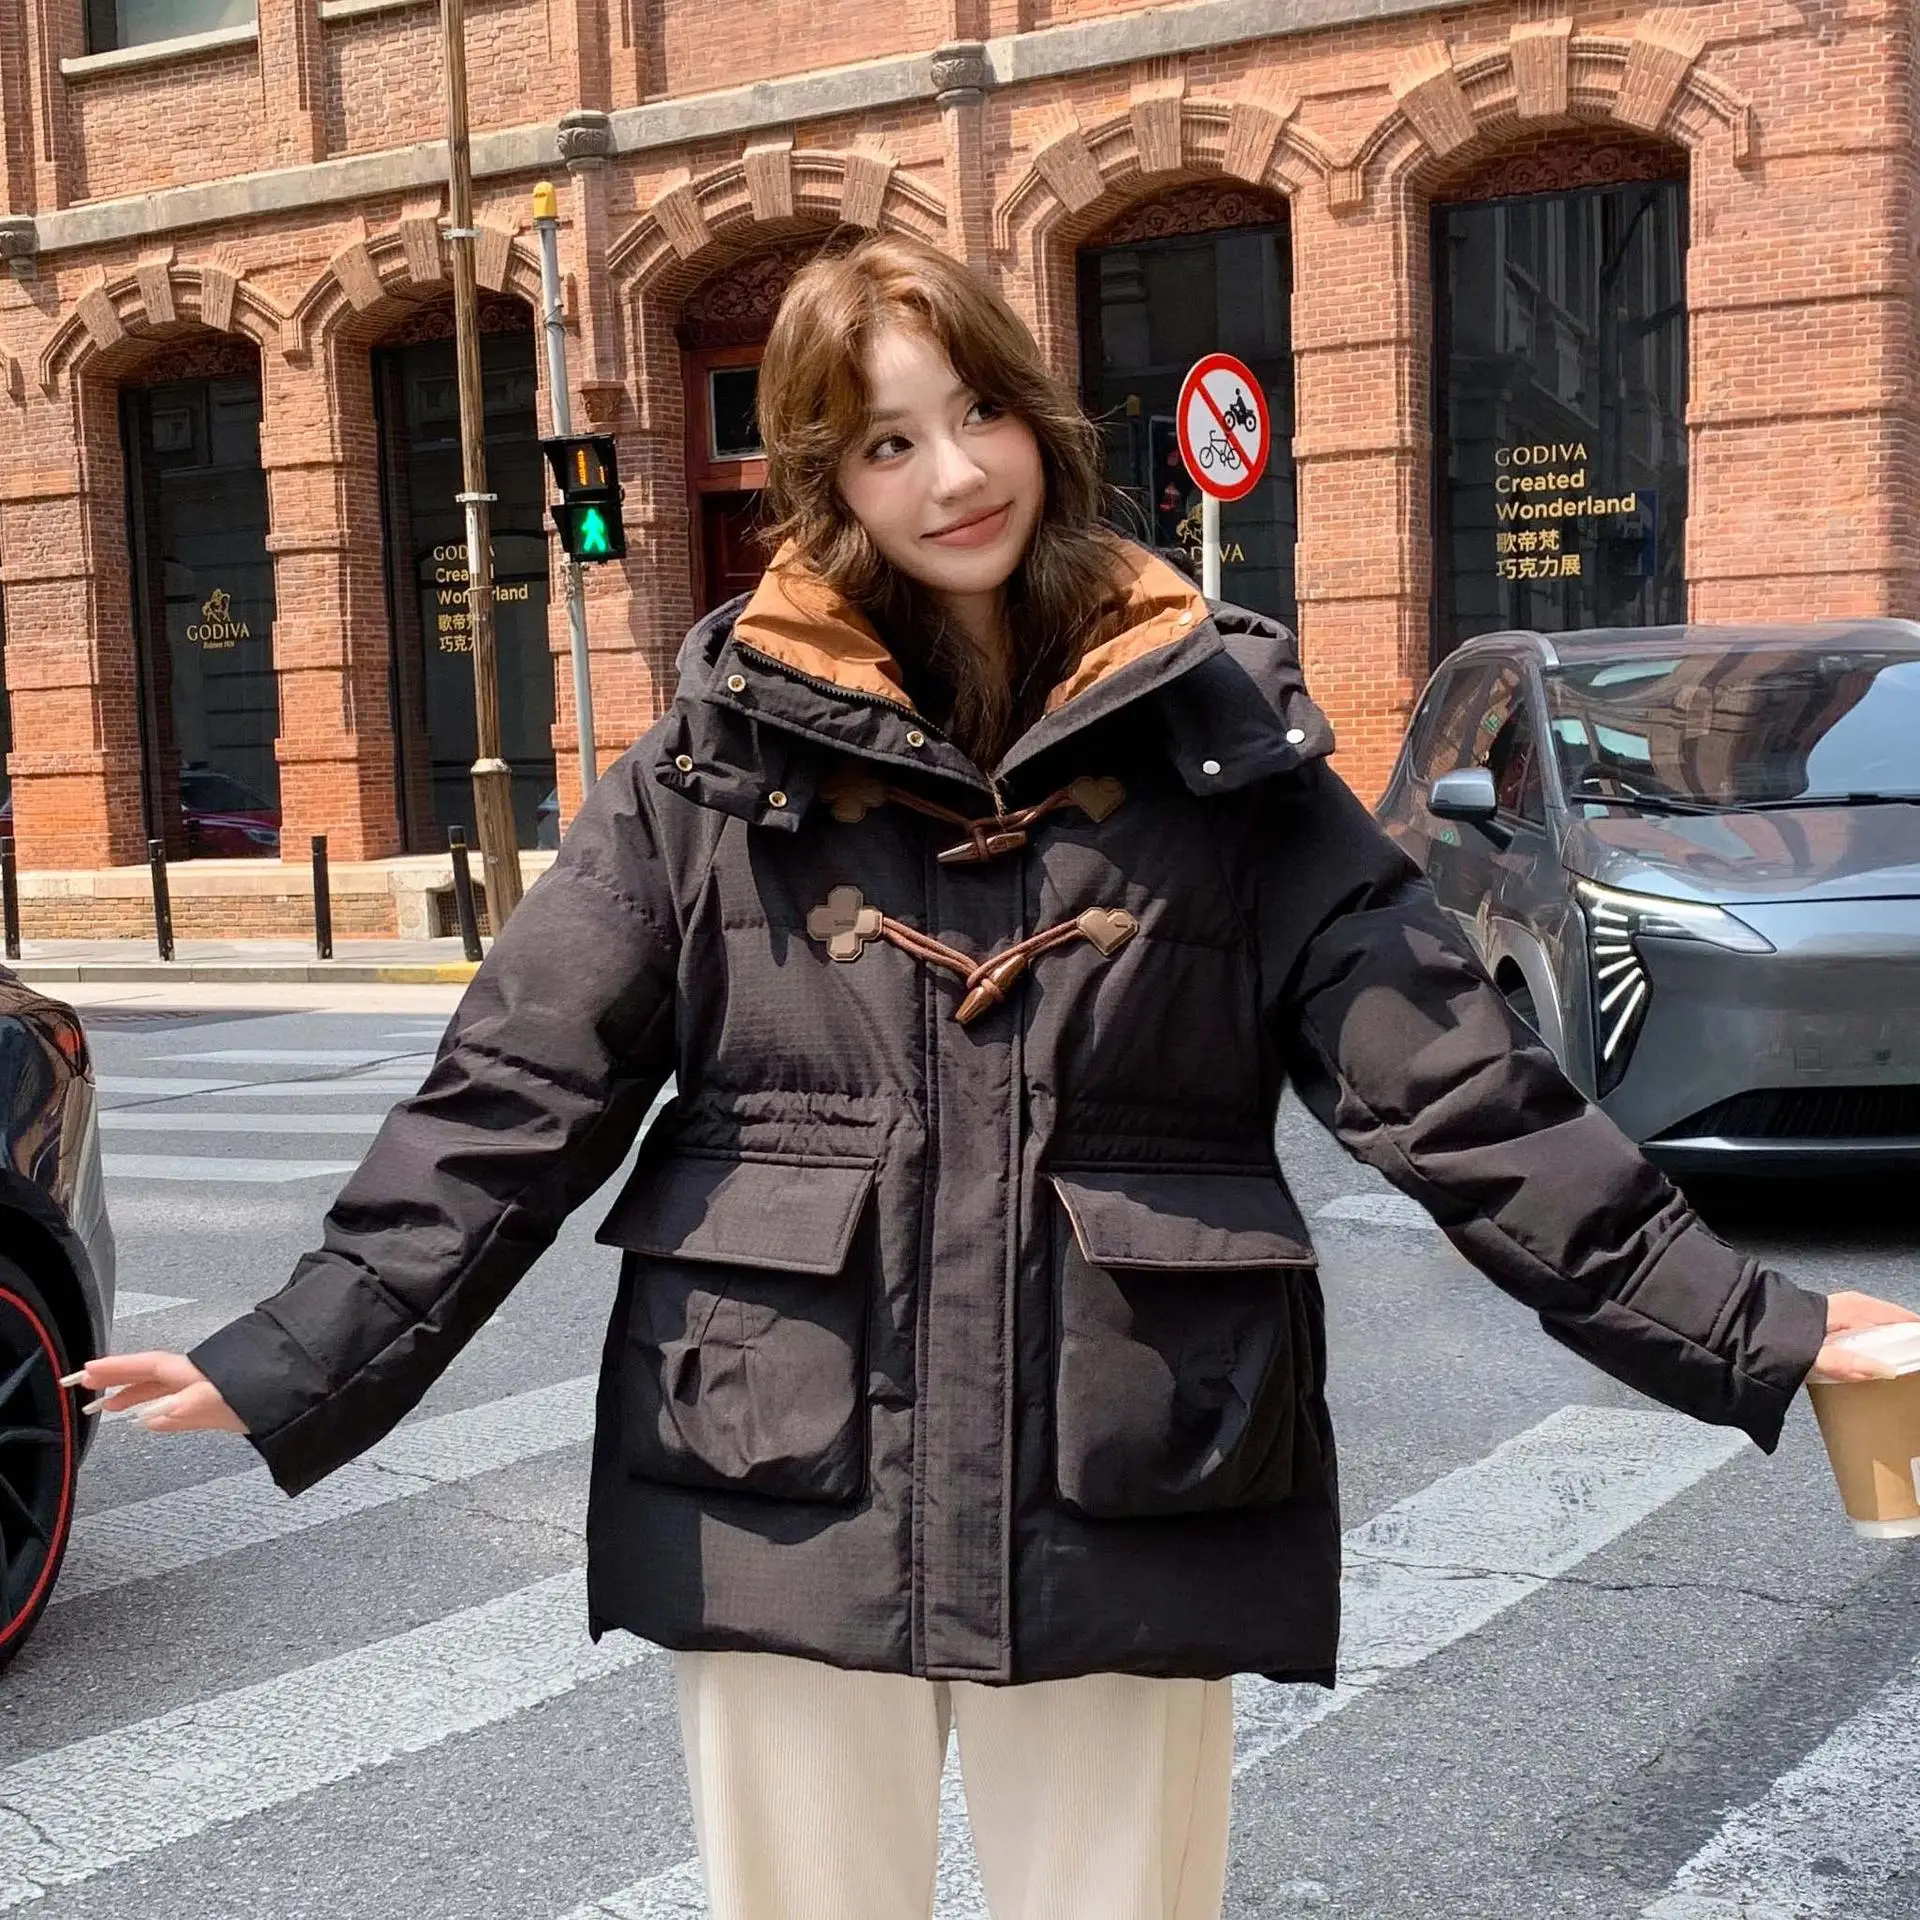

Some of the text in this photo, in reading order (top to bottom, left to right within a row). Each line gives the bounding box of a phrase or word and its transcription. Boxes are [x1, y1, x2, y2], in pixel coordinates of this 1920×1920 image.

[1495, 443, 1588, 467] GODIVA
[1495, 468, 1586, 493] Created
[1495, 492, 1636, 520] Wonderland
[1496, 528, 1560, 553] 歌帝梵
[1495, 554, 1581, 580] 巧克力展
[186, 622, 250, 641] GODIVA
